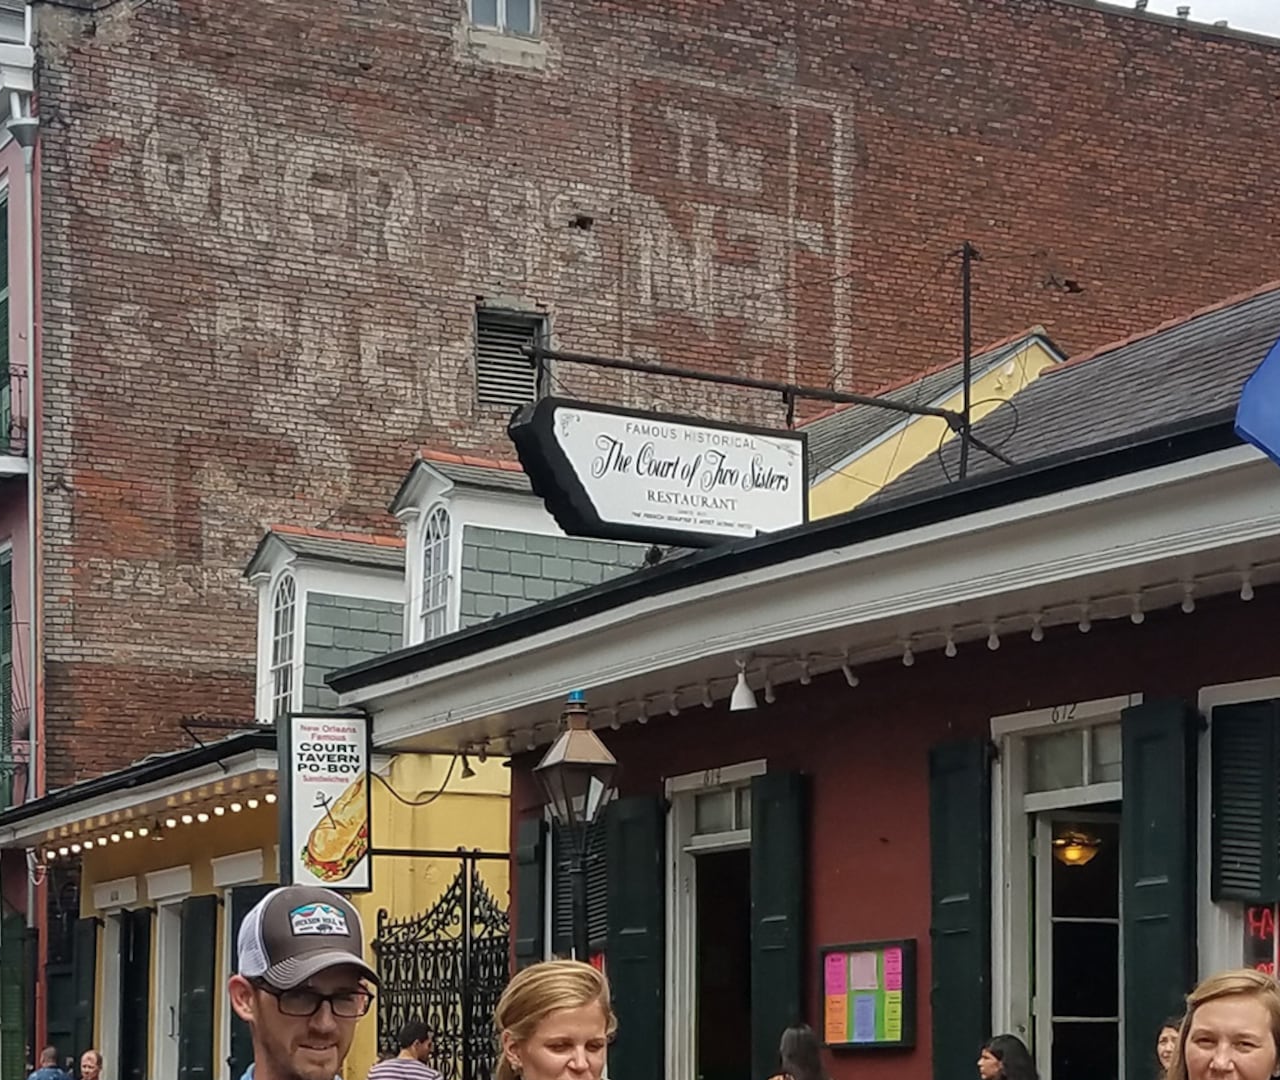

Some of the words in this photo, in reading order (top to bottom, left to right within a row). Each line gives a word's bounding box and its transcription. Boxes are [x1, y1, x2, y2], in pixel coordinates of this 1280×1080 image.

[625, 422, 677, 440] FAMOUS
[683, 430, 757, 451] HISTORICAL
[591, 434, 632, 479] The
[636, 442, 679, 479] Court
[681, 453, 702, 488] of
[700, 449, 738, 492] Two
[741, 454, 789, 492] Sisters
[647, 490, 737, 511] RESTAURANT
[322, 724, 357, 733] Orleans
[311, 733, 347, 742] Famous
[299, 743, 358, 753] COURT
[296, 753, 360, 763] TAVERN
[297, 764, 361, 774] PO-BOY
[302, 775, 350, 784] Sandwiches
